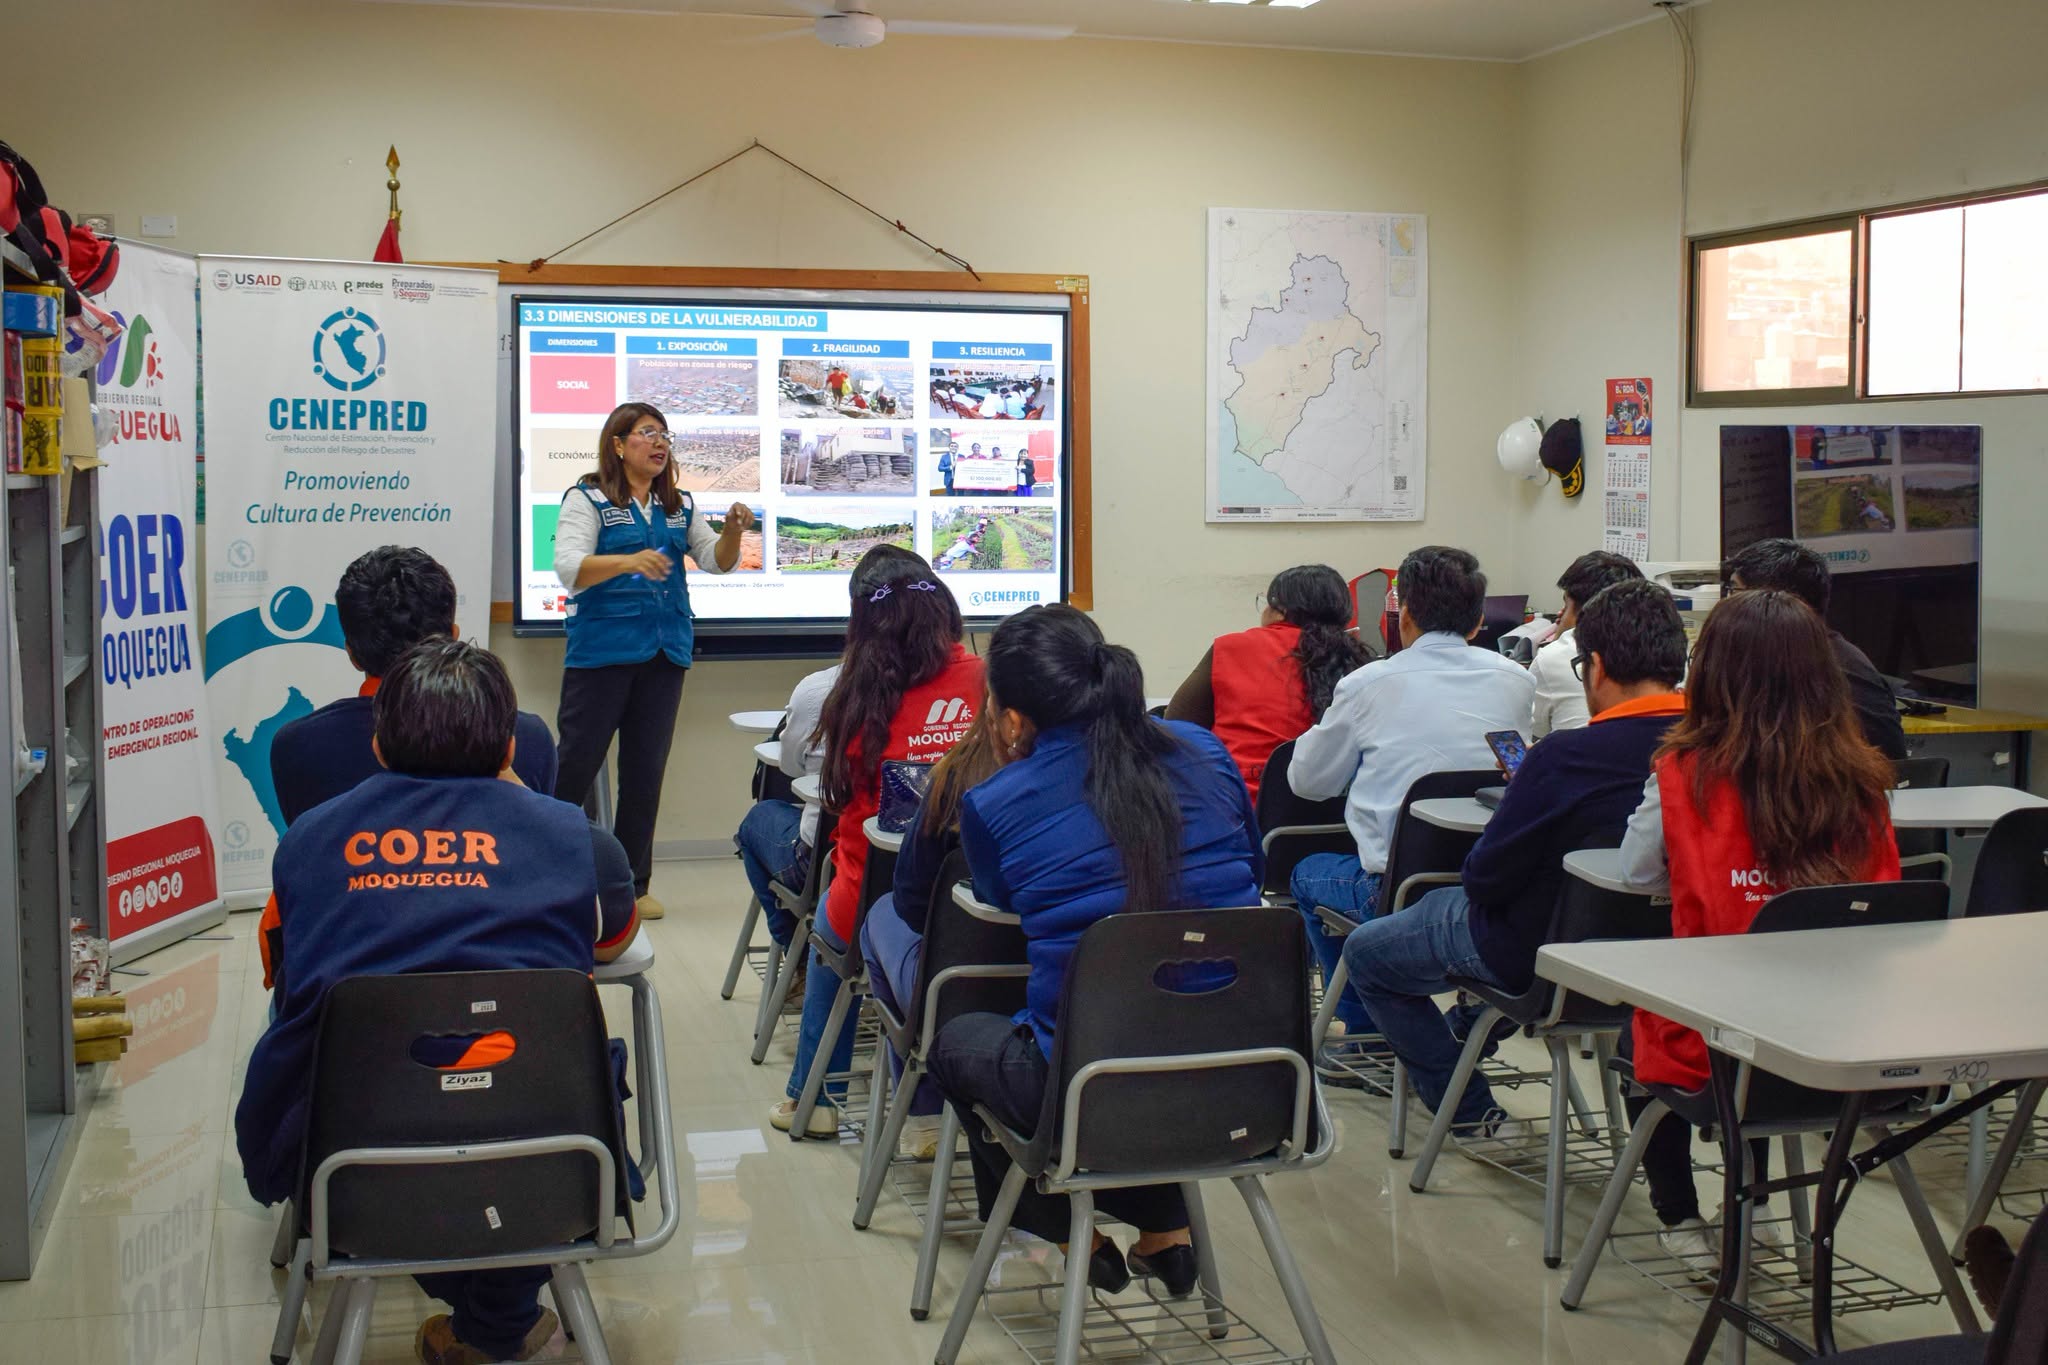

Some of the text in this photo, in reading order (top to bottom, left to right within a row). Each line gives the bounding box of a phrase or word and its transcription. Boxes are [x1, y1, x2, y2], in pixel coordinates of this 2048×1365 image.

[235, 274, 281, 286] USAID
[307, 279, 337, 291] ADRA
[357, 280, 383, 289] predes
[524, 310, 817, 327] 3.3 DIMENSIONES DE LA VULNERABILIDAD
[548, 338, 598, 347] DIMENSIONES
[657, 340, 728, 352] 1. EXPOSICIÓN
[812, 344, 881, 354] 2. FRAGILIDAD
[960, 346, 1025, 356] 3. RESILIENCIA
[640, 360, 679, 368] Población
[713, 361, 724, 369] de
[728, 362, 752, 371] riesgo
[557, 380, 590, 390] SOCIAL
[98, 393, 129, 404] OBIERNO
[269, 397, 427, 432] CENEPRED
[265, 433, 292, 442] Centro
[293, 433, 329, 442] Nacional
[331, 433, 339, 442] de
[388, 434, 427, 444] Prevención
[428, 436, 436, 446] y
[283, 444, 416, 457] Reducción del Riesgo de Desastres
[548, 450, 600, 460] ECONÓMICA
[284, 470, 410, 491] Promoviendo
[246, 502, 451, 524] Cultura de Prevención
[964, 506, 1014, 515] Reforestación
[984, 590, 1040, 602] CENEPRED
[103, 623, 192, 690] OQUEGUA
[103, 723, 128, 741] NTRO
[129, 720, 141, 735] DE
[908, 730, 969, 747] MOQUE
[108, 735, 161, 760] EMERGENCIA
[344, 829, 500, 867] COER
[222, 848, 265, 865] NEPRED
[107, 845, 201, 888] BIERNO REGIONAL MOQUEGUA
[347, 871, 489, 892] MOQUEGUA
[446, 1075, 486, 1086] Ziyaz
